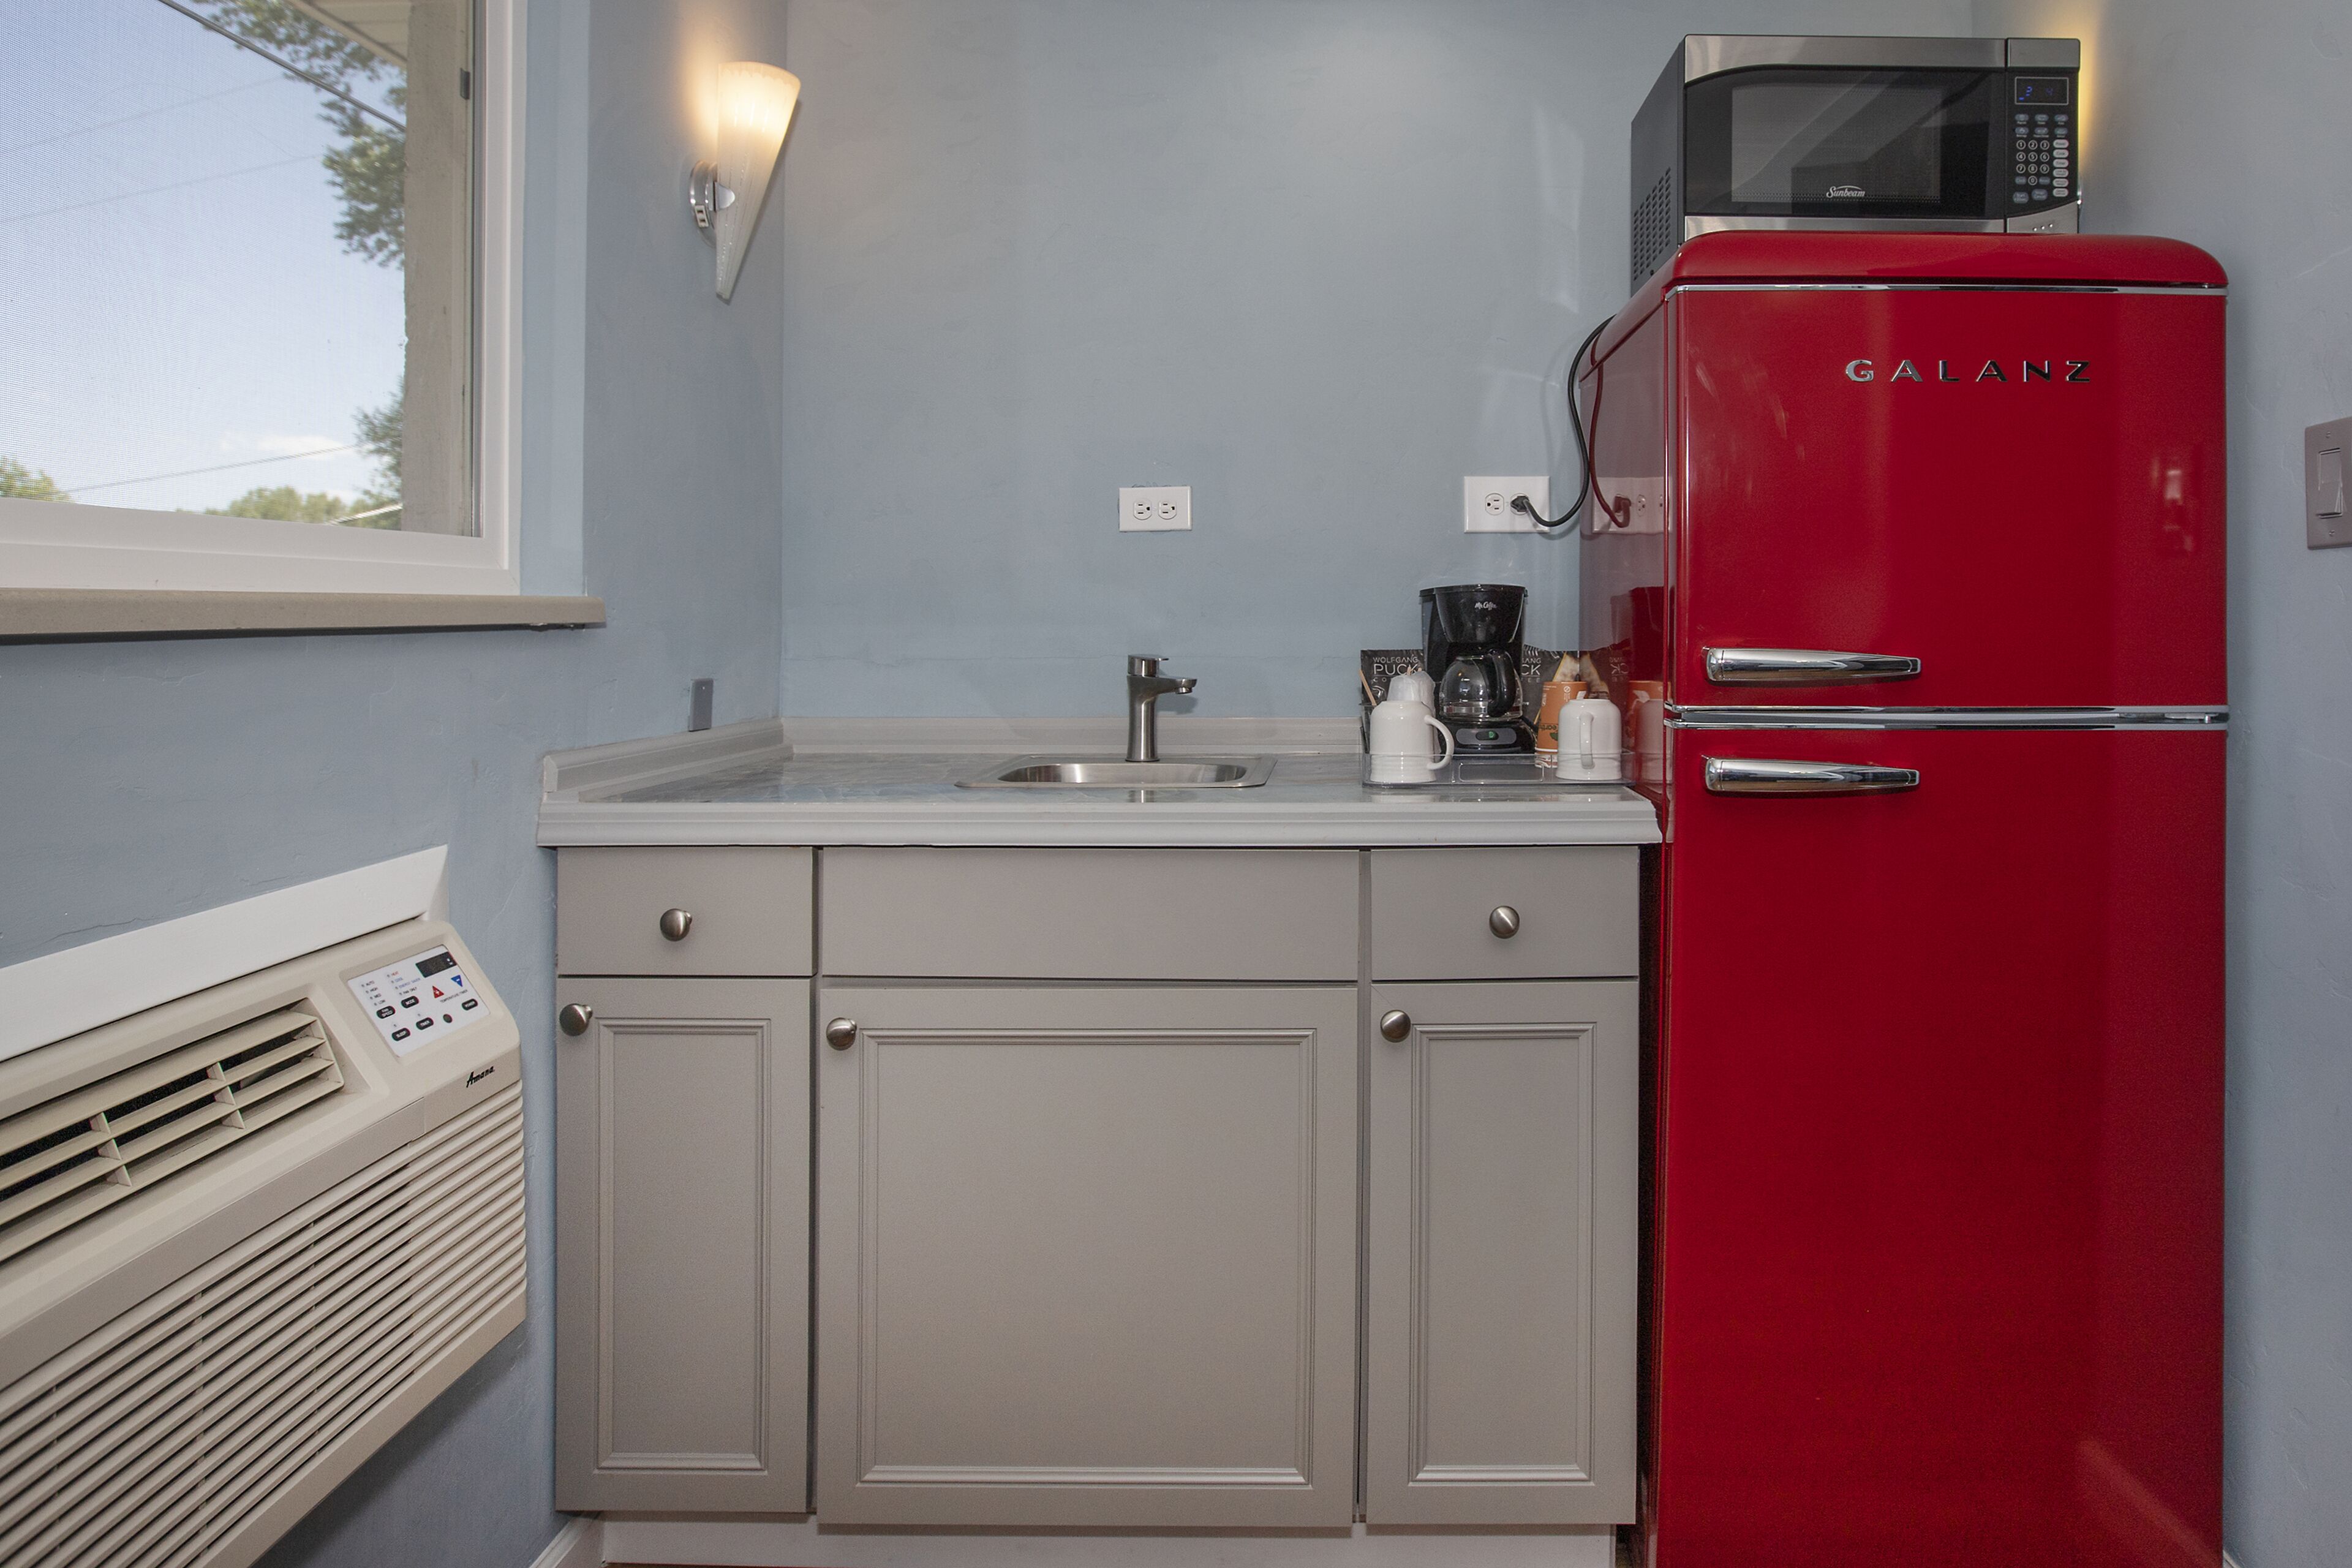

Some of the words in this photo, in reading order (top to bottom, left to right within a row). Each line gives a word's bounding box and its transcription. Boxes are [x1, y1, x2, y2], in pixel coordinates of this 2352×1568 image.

[1826, 186, 1865, 198] Sunbeam
[1845, 359, 2090, 383] GALANZ
[1374, 664, 1417, 675] PUCK
[466, 1066, 494, 1088] Amana
